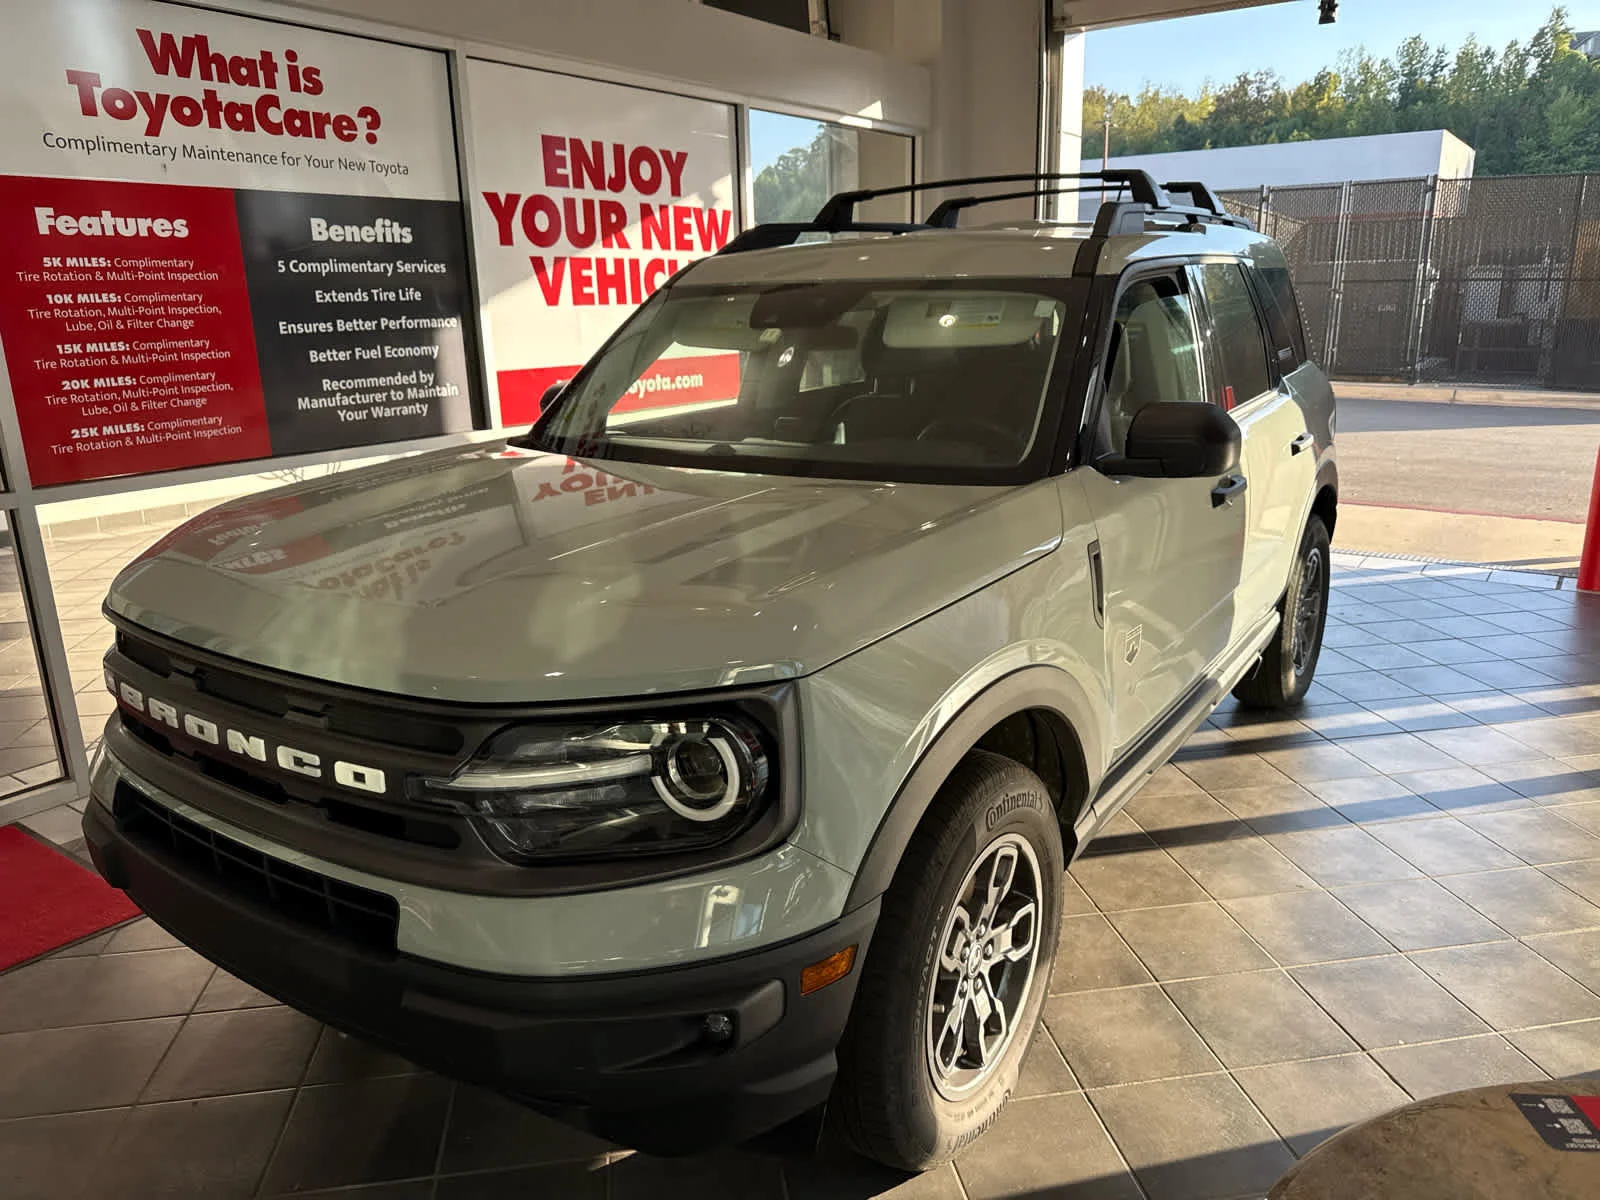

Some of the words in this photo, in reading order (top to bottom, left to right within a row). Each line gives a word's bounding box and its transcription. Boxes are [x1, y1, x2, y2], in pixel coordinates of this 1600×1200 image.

[136, 28, 279, 89] What
[284, 49, 323, 95] is
[66, 69, 382, 145] ToyotaCare?
[43, 132, 177, 160] Complimentary
[182, 145, 278, 166] Maintenance
[281, 152, 301, 167] for
[304, 154, 334, 170] Your
[338, 159, 366, 172] New
[368, 160, 409, 176] Toyota
[541, 134, 688, 197] ENJOY
[34, 206, 189, 238] Features
[310, 217, 413, 244] Benefits
[482, 191, 631, 249] YOUR
[640, 202, 732, 252] NEW
[43, 257, 63, 268] 5K
[66, 257, 111, 268] MILES:
[114, 257, 194, 272] Complimentary
[278, 260, 286, 273] 5
[289, 259, 394, 277] Complimentary
[396, 260, 446, 273] Services
[16, 271, 40, 282] Tire
[43, 271, 92, 282] Rotation
[95, 271, 104, 281] &
[106, 271, 165, 282] Multi-Point
[167, 270, 219, 283] Inspection
[529, 256, 694, 306] VEHIC
[46, 294, 74, 304] 10K
[77, 293, 121, 304] MILES:
[124, 292, 203, 306] Complimentary
[315, 288, 369, 303] Extends
[371, 288, 396, 302] Tire
[399, 287, 422, 301] Life
[27, 308, 51, 319] Tire
[54, 307, 106, 319] Rotation,
[107, 306, 165, 317] Multi-Point
[168, 305, 222, 318] Inspection,
[66, 320, 97, 333] Lube,
[98, 320, 113, 330] Oil
[116, 320, 124, 329] &
[127, 318, 154, 329] Filter
[156, 318, 195, 330] Change
[278, 319, 333, 335] Ensures
[337, 318, 377, 332] Better
[380, 315, 457, 331] Performance
[56, 344, 82, 354] 15K
[86, 342, 130, 353] MILES:
[132, 338, 210, 351] Complimentary
[309, 348, 351, 363] Better
[355, 345, 381, 360] Fuel
[385, 345, 439, 361] Economy
[34, 359, 57, 370] Tire
[60, 357, 108, 368] Rotation
[110, 356, 119, 365] &
[122, 352, 178, 364] Multi-Point
[181, 349, 231, 363] Inspection
[61, 380, 90, 390] 20K
[93, 376, 136, 388] MILES:
[139, 371, 216, 386] Complimentary
[322, 371, 417, 391] Recommended
[419, 370, 435, 386] by
[625, 373, 704, 399] oyota.com
[44, 395, 68, 406] Tire
[70, 391, 121, 404] Rotation,
[122, 385, 178, 398] Multi-Point
[180, 382, 234, 397] Inspection,
[297, 390, 388, 410] Manufacturer
[390, 389, 404, 401] to
[407, 384, 459, 400] Maintain
[81, 404, 112, 417] Lube,
[113, 402, 128, 413] Oil
[130, 401, 139, 411] &
[141, 399, 167, 410] Filter
[170, 396, 207, 410] Change
[337, 407, 368, 422] Your
[371, 402, 429, 419] Warranty
[71, 427, 99, 439] 25K
[102, 423, 145, 436] MILES:
[147, 415, 223, 432] Complimentary
[51, 444, 73, 455] Tire
[76, 439, 123, 452] Rotation
[125, 437, 134, 447] &
[136, 430, 191, 445] Multi-Point
[193, 424, 242, 440] Inspection
[120, 681, 386, 794] BRONCO
[985, 791, 1038, 832] Continental
